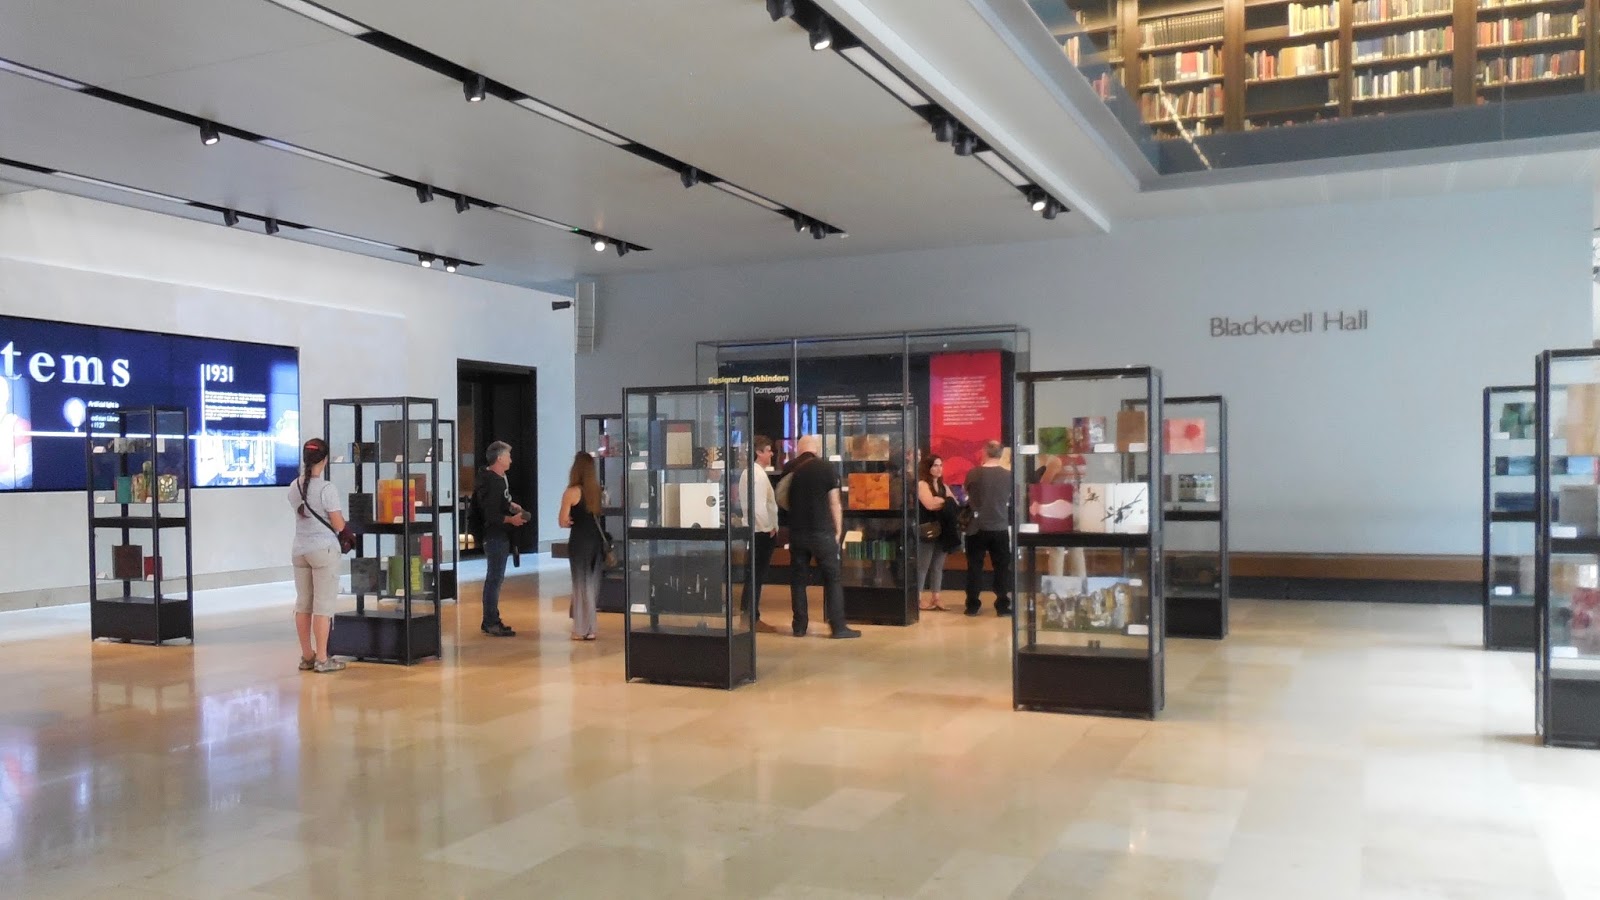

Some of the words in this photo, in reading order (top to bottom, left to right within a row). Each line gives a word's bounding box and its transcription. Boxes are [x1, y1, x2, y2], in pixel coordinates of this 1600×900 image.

[1210, 312, 1312, 337] Blackwell
[1323, 310, 1368, 331] Hall
[0, 341, 130, 387] tems
[206, 364, 234, 383] 1931
[742, 375, 789, 383] Bookbinders
[754, 386, 789, 394] Competition
